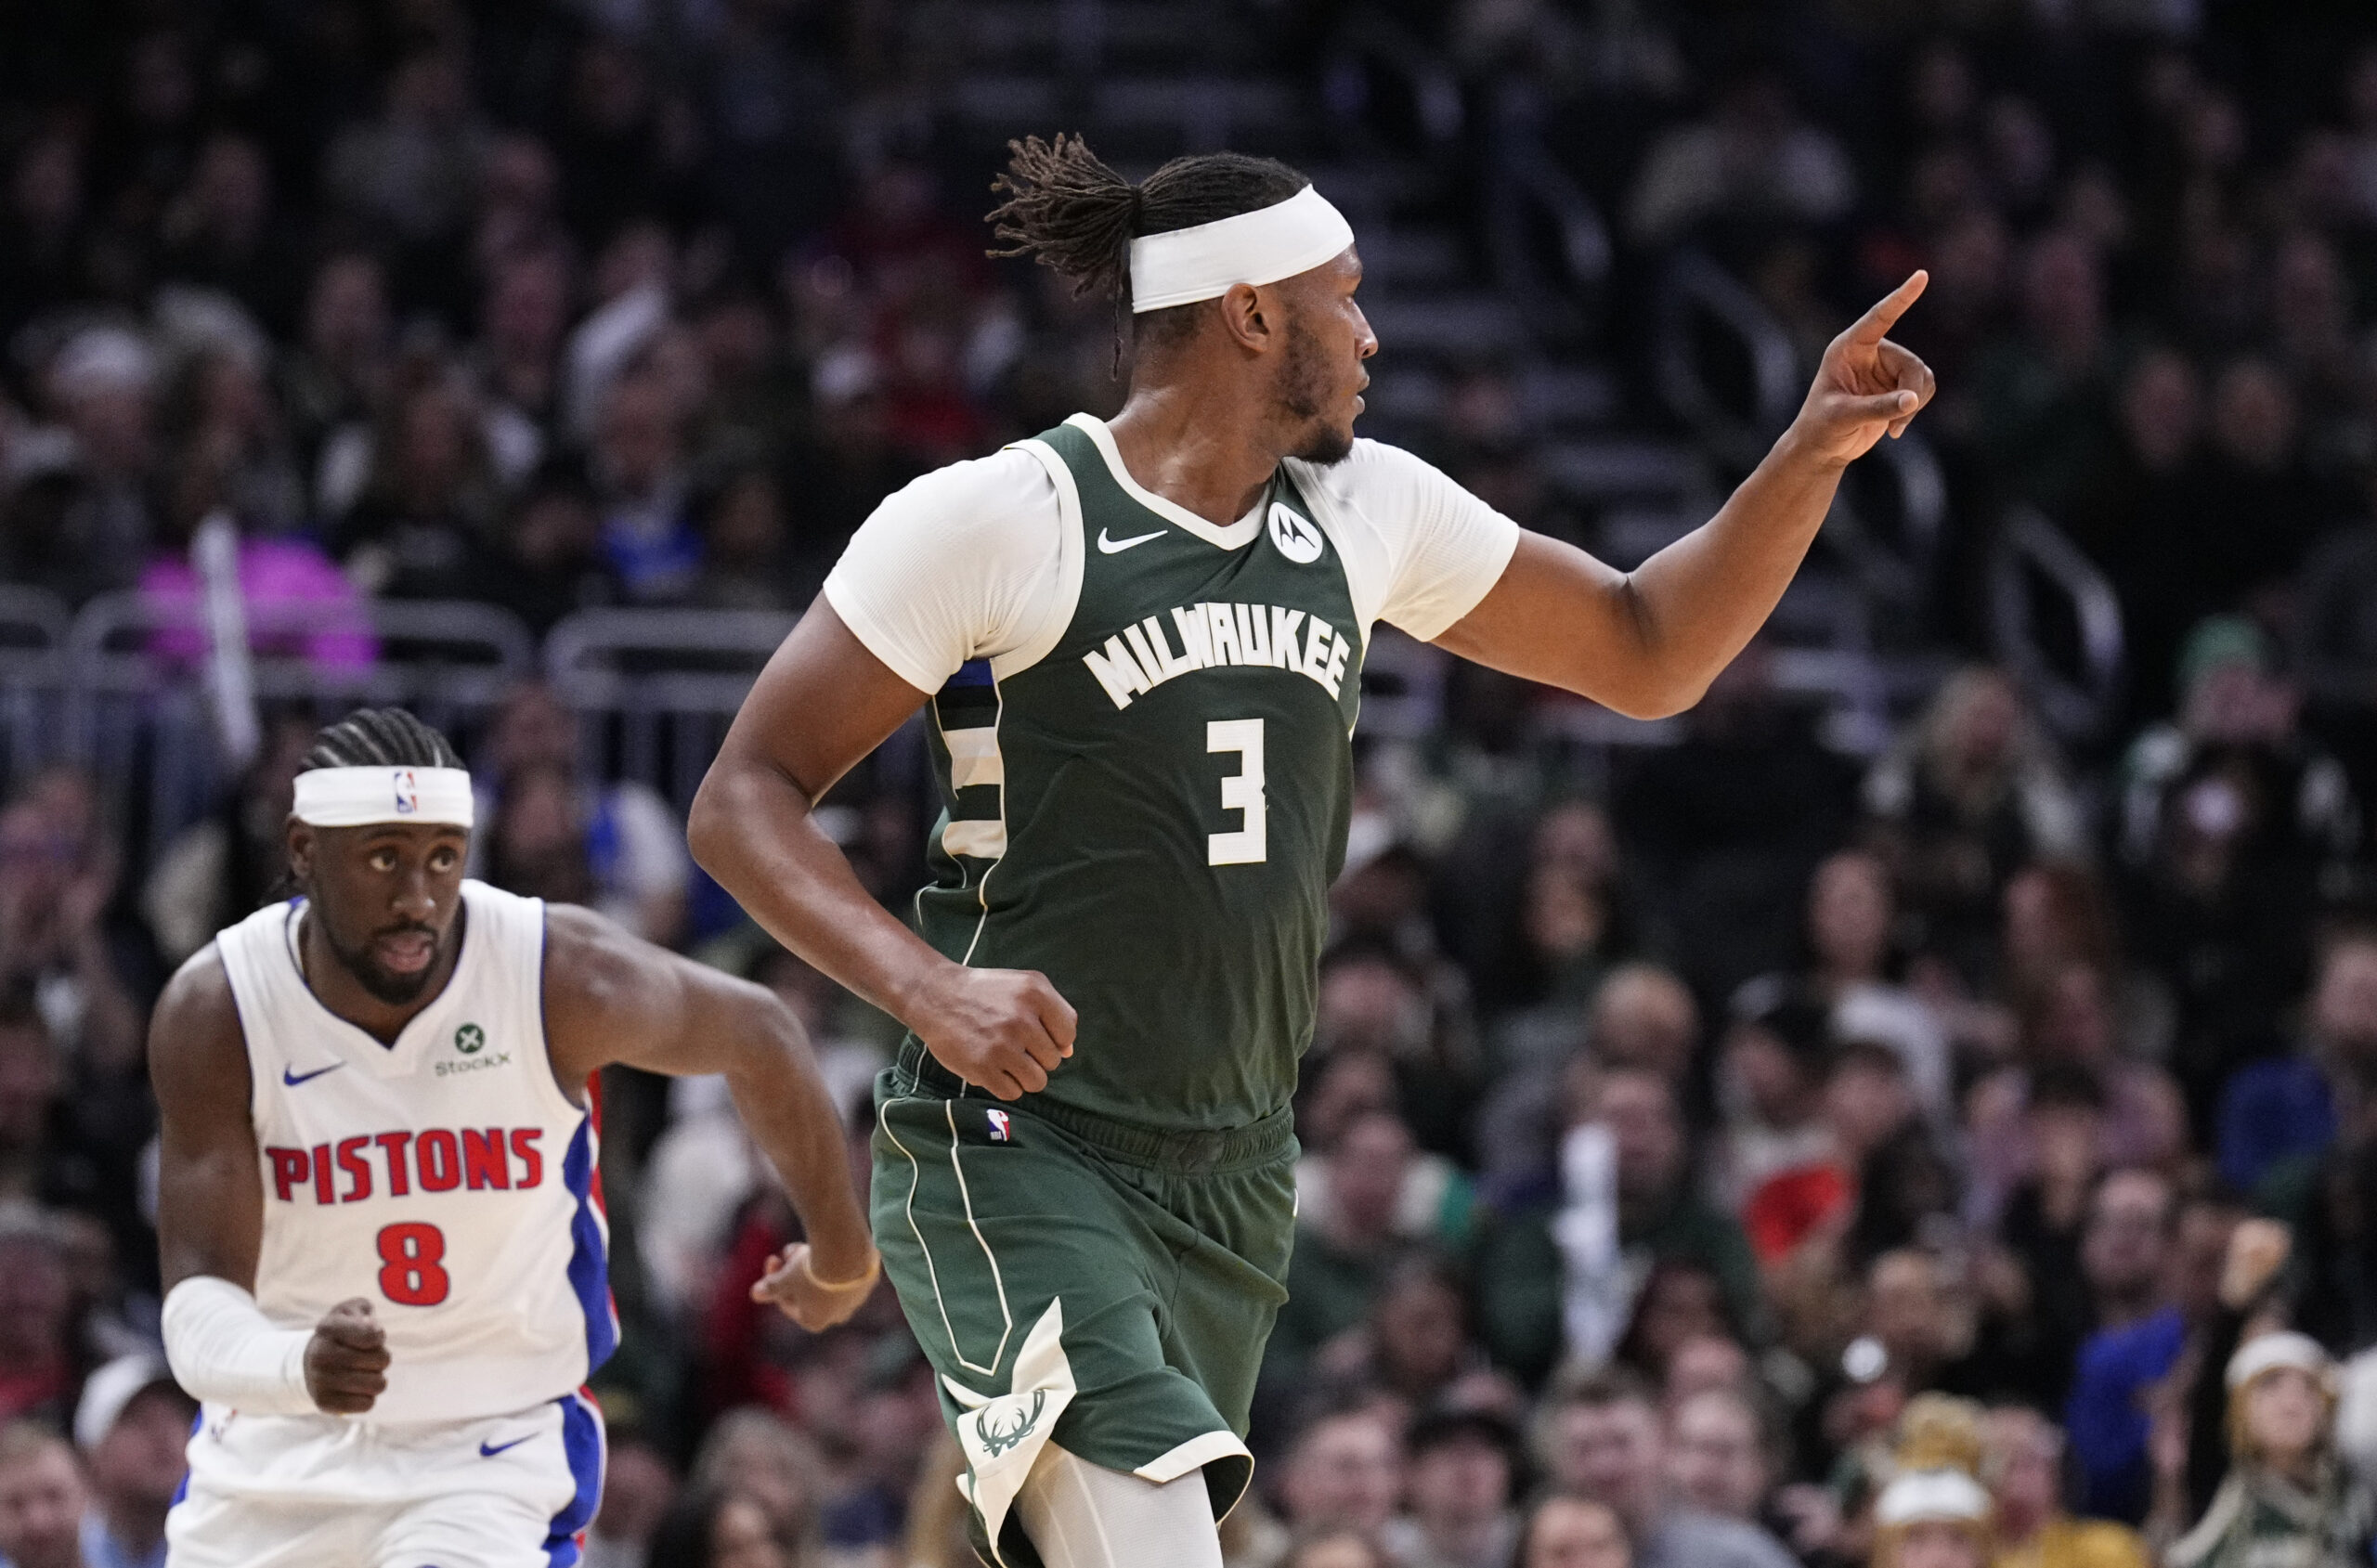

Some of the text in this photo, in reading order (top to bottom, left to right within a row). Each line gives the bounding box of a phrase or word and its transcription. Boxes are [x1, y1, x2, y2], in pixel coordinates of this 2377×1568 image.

[1083, 603, 1351, 711] MILWAUKEE
[1207, 719, 1266, 865] 3
[266, 1127, 544, 1206] PISTONS
[377, 1222, 449, 1306] 8
